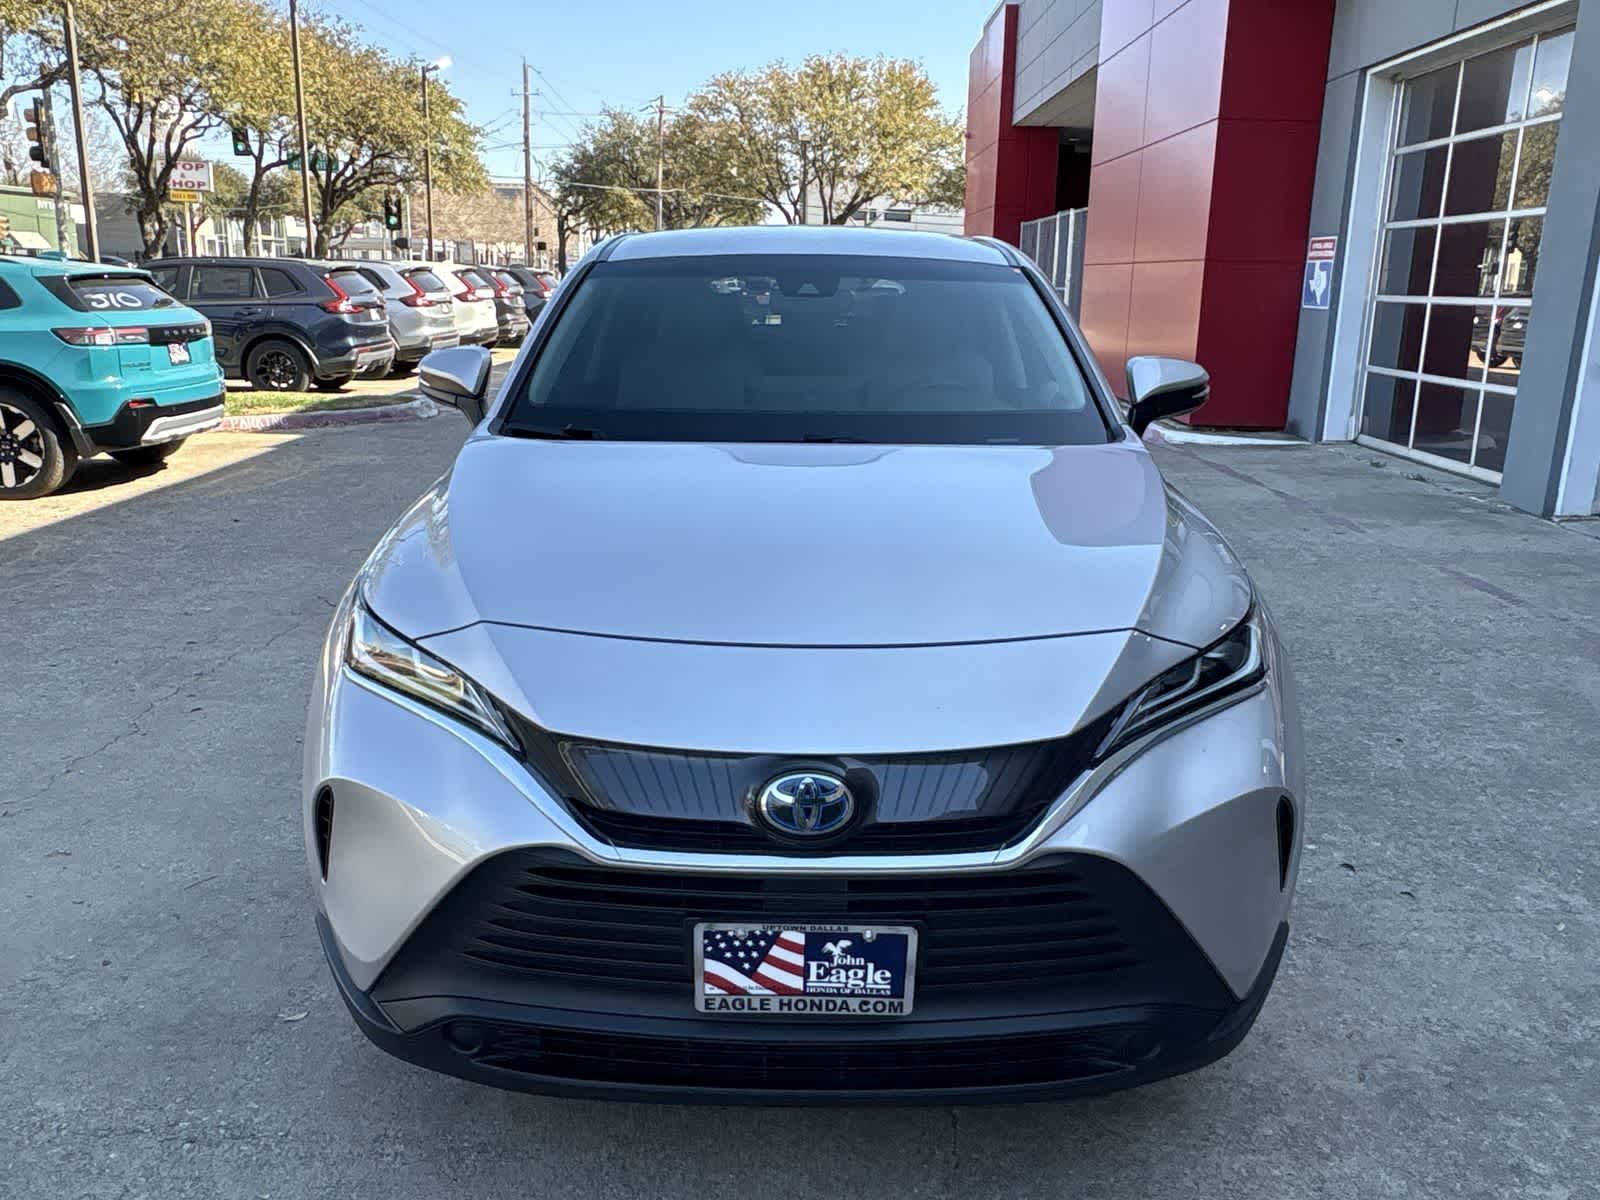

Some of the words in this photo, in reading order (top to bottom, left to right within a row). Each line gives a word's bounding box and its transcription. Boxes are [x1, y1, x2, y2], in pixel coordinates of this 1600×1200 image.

[165, 162, 205, 171] TOP
[166, 179, 206, 188] HOP
[830, 954, 865, 967] John
[807, 961, 892, 988] Eagle
[854, 987, 892, 995] DALLAS
[704, 998, 771, 1011] EAGLE
[779, 998, 904, 1013] HONDA.COM
